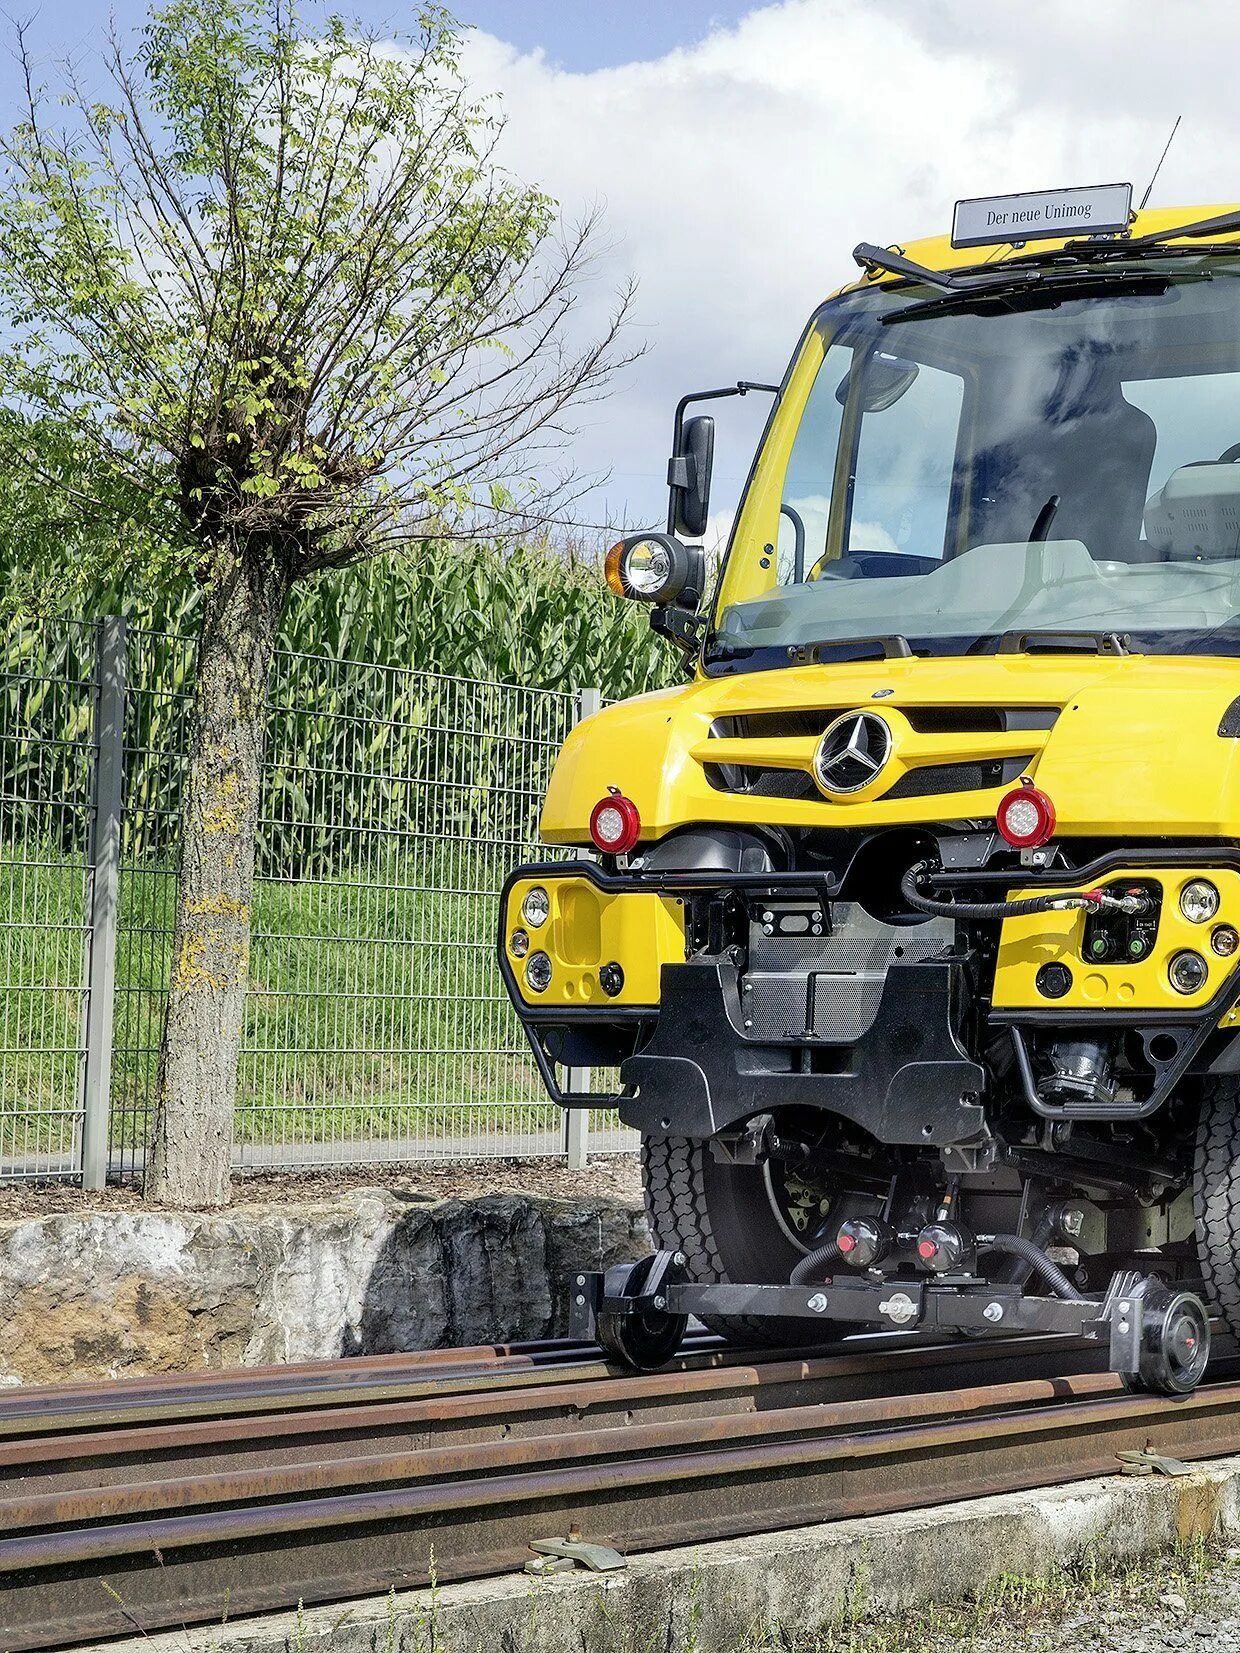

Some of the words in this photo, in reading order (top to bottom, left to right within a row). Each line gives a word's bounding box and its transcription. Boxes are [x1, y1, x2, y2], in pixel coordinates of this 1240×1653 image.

[986, 211, 1009, 226] Der
[1011, 208, 1041, 223] neue
[1044, 203, 1093, 221] Unimog
